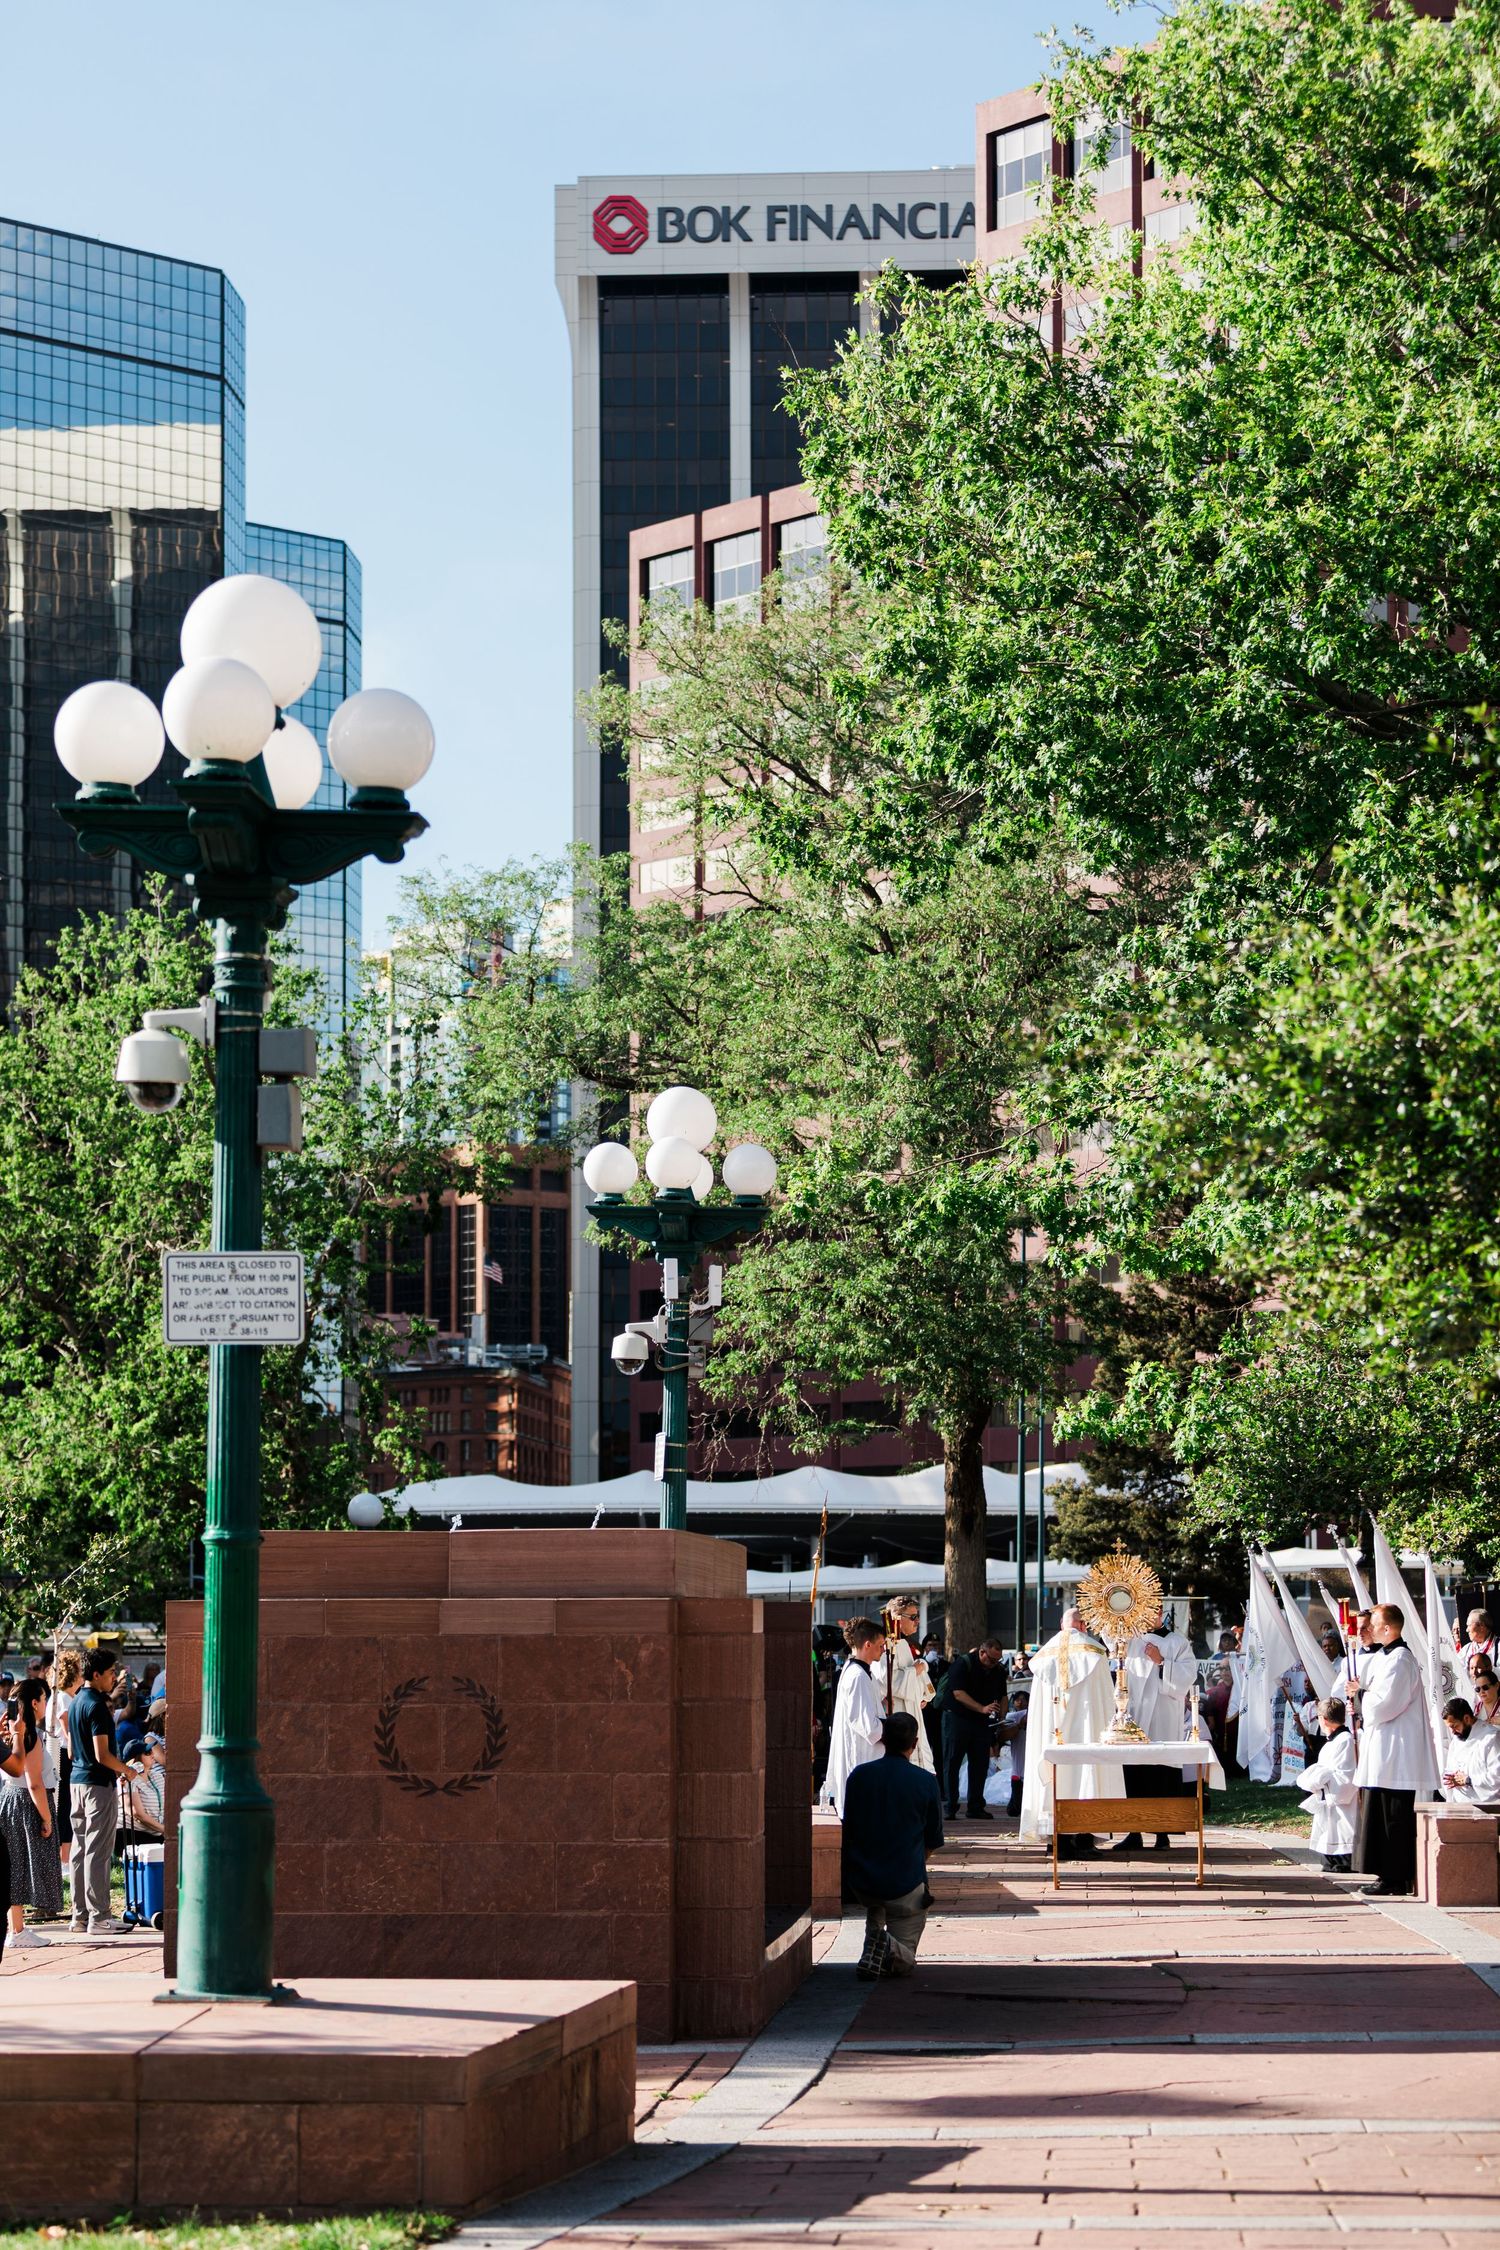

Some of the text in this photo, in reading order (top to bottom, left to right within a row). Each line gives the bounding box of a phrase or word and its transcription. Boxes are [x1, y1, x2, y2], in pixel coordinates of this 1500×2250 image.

[657, 205, 753, 243] BOK
[176, 1261, 292, 1269] THIS AREA IS CLOSED TO
[171, 1274, 190, 1282] THE
[192, 1274, 226, 1282] PUBLIC
[179, 1287, 192, 1296] TO
[193, 1301, 236, 1309] UBCT
[239, 1301, 252, 1309] TO
[253, 1301, 296, 1309] CITATION
[173, 1314, 187, 1322] OR
[282, 1314, 295, 1322] TO
